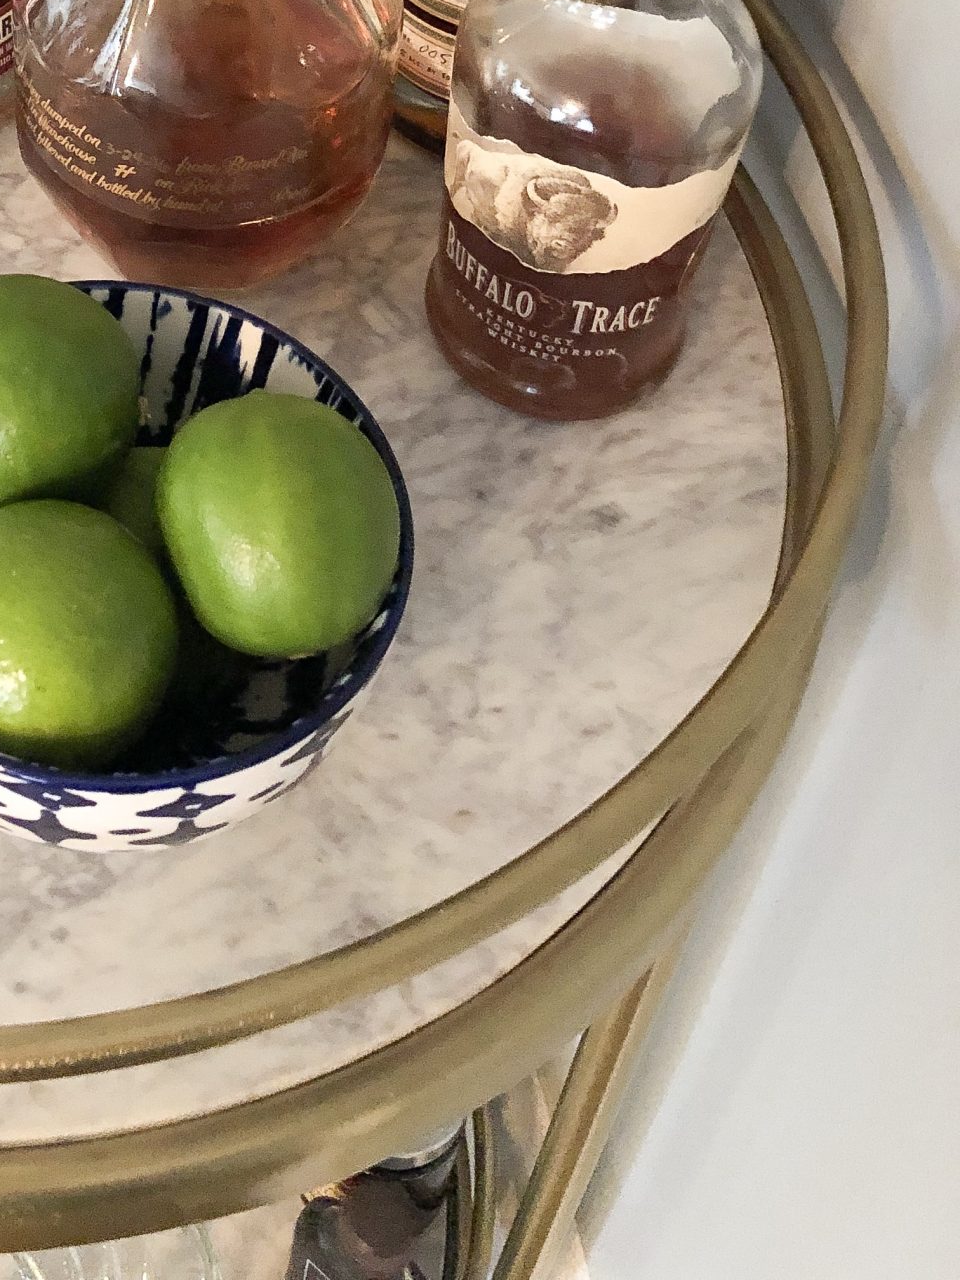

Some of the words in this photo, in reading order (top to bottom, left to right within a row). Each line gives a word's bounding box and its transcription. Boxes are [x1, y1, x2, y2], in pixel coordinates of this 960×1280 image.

[40, 98, 87, 138] dumped
[84, 133, 102, 151] on
[70, 164, 98, 185] and
[96, 174, 144, 204] bottled
[140, 191, 161, 210] by
[445, 220, 534, 319] BUFFALO
[569, 295, 661, 335] TRACE
[486, 308, 575, 347] KENTUCKY
[487, 327, 561, 363] WHISKEY
[535, 341, 617, 358] BOURBON
